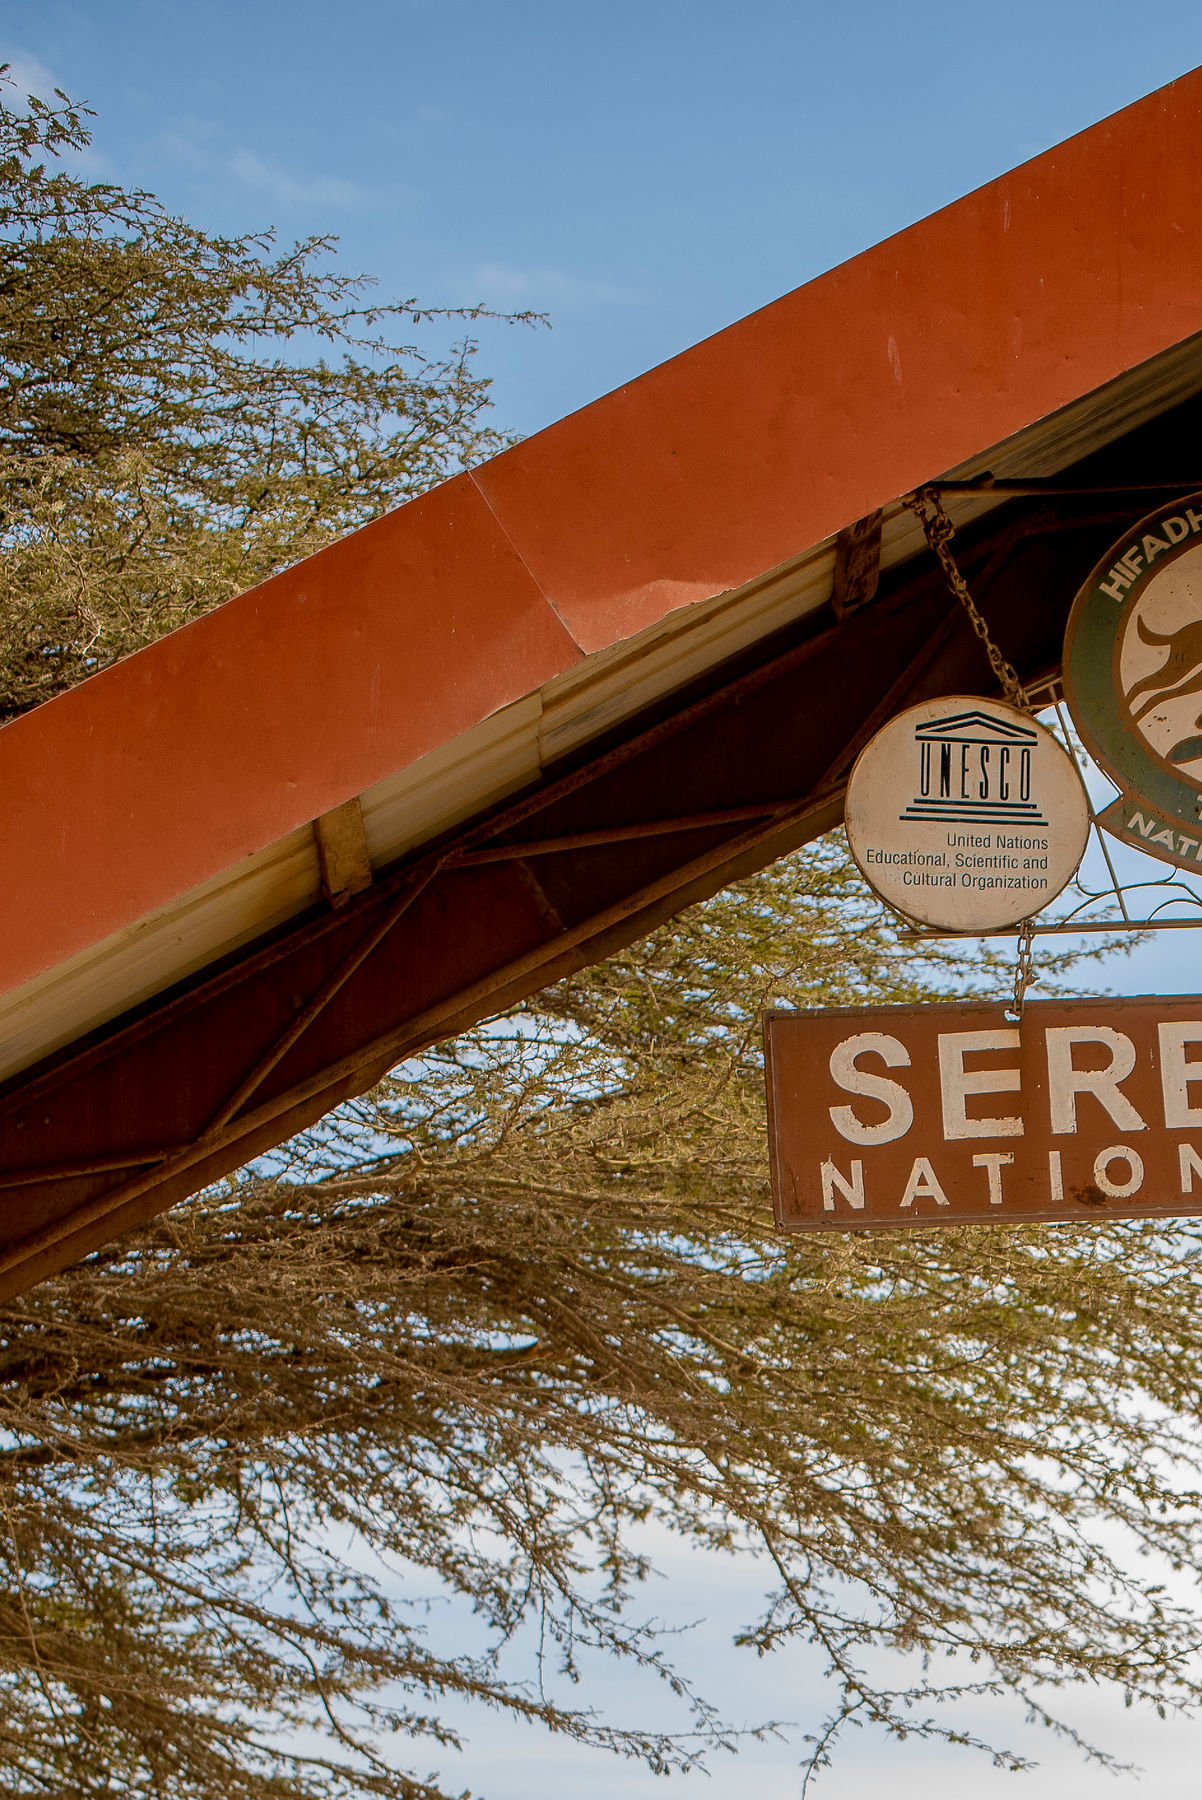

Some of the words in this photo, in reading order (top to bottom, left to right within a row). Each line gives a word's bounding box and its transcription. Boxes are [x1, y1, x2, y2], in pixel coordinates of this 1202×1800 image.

[920, 742, 1031, 801] UNESCO
[947, 832, 991, 849] United
[996, 834, 1049, 850] Nations
[866, 849, 951, 869] Educational,
[955, 853, 1019, 870] Scientific
[1023, 856, 1048, 870] and
[903, 871, 957, 888] Cultural
[961, 873, 1049, 891] Organization
